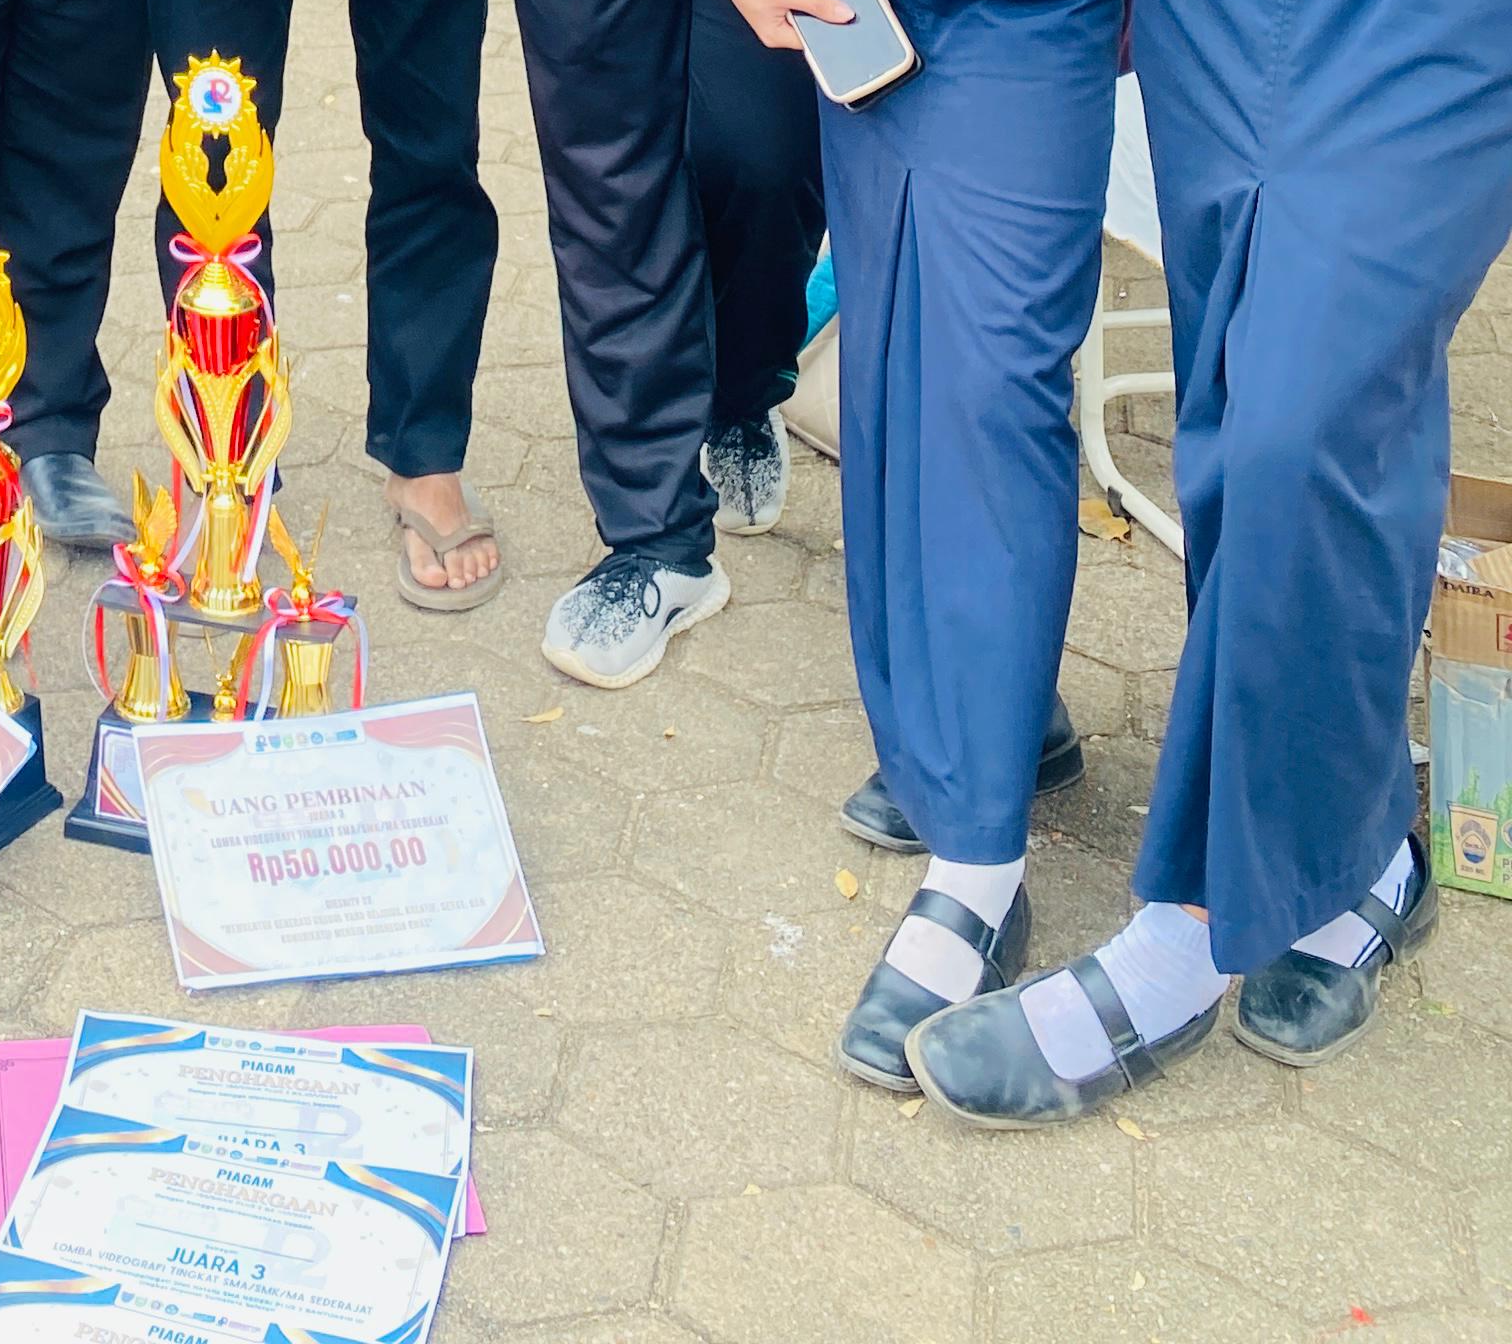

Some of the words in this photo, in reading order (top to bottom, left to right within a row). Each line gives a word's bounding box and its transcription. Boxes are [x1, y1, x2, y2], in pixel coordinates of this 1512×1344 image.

[209, 795, 278, 816] UANG
[284, 779, 427, 810] PEMBINAAN
[248, 836, 427, 886] Rp50.000,00
[176, 1064, 361, 1097] PENGHARGAAN
[241, 1060, 296, 1075] PIAGAM
[147, 1166, 339, 1217] PENGHARGAAN
[216, 1167, 274, 1190] PIAGAM
[52, 1241, 93, 1258] LOMBA
[98, 1250, 167, 1273] VIDEOGRAFI
[169, 1265, 221, 1284] TINGKAT
[223, 1277, 305, 1304] SMA/SMK/MA
[310, 1295, 373, 1316] SEDERAJAT
[167, 1247, 239, 1276] JUARA
[250, 1264, 266, 1281] 3
[148, 1324, 208, 1344] PIAGAM
